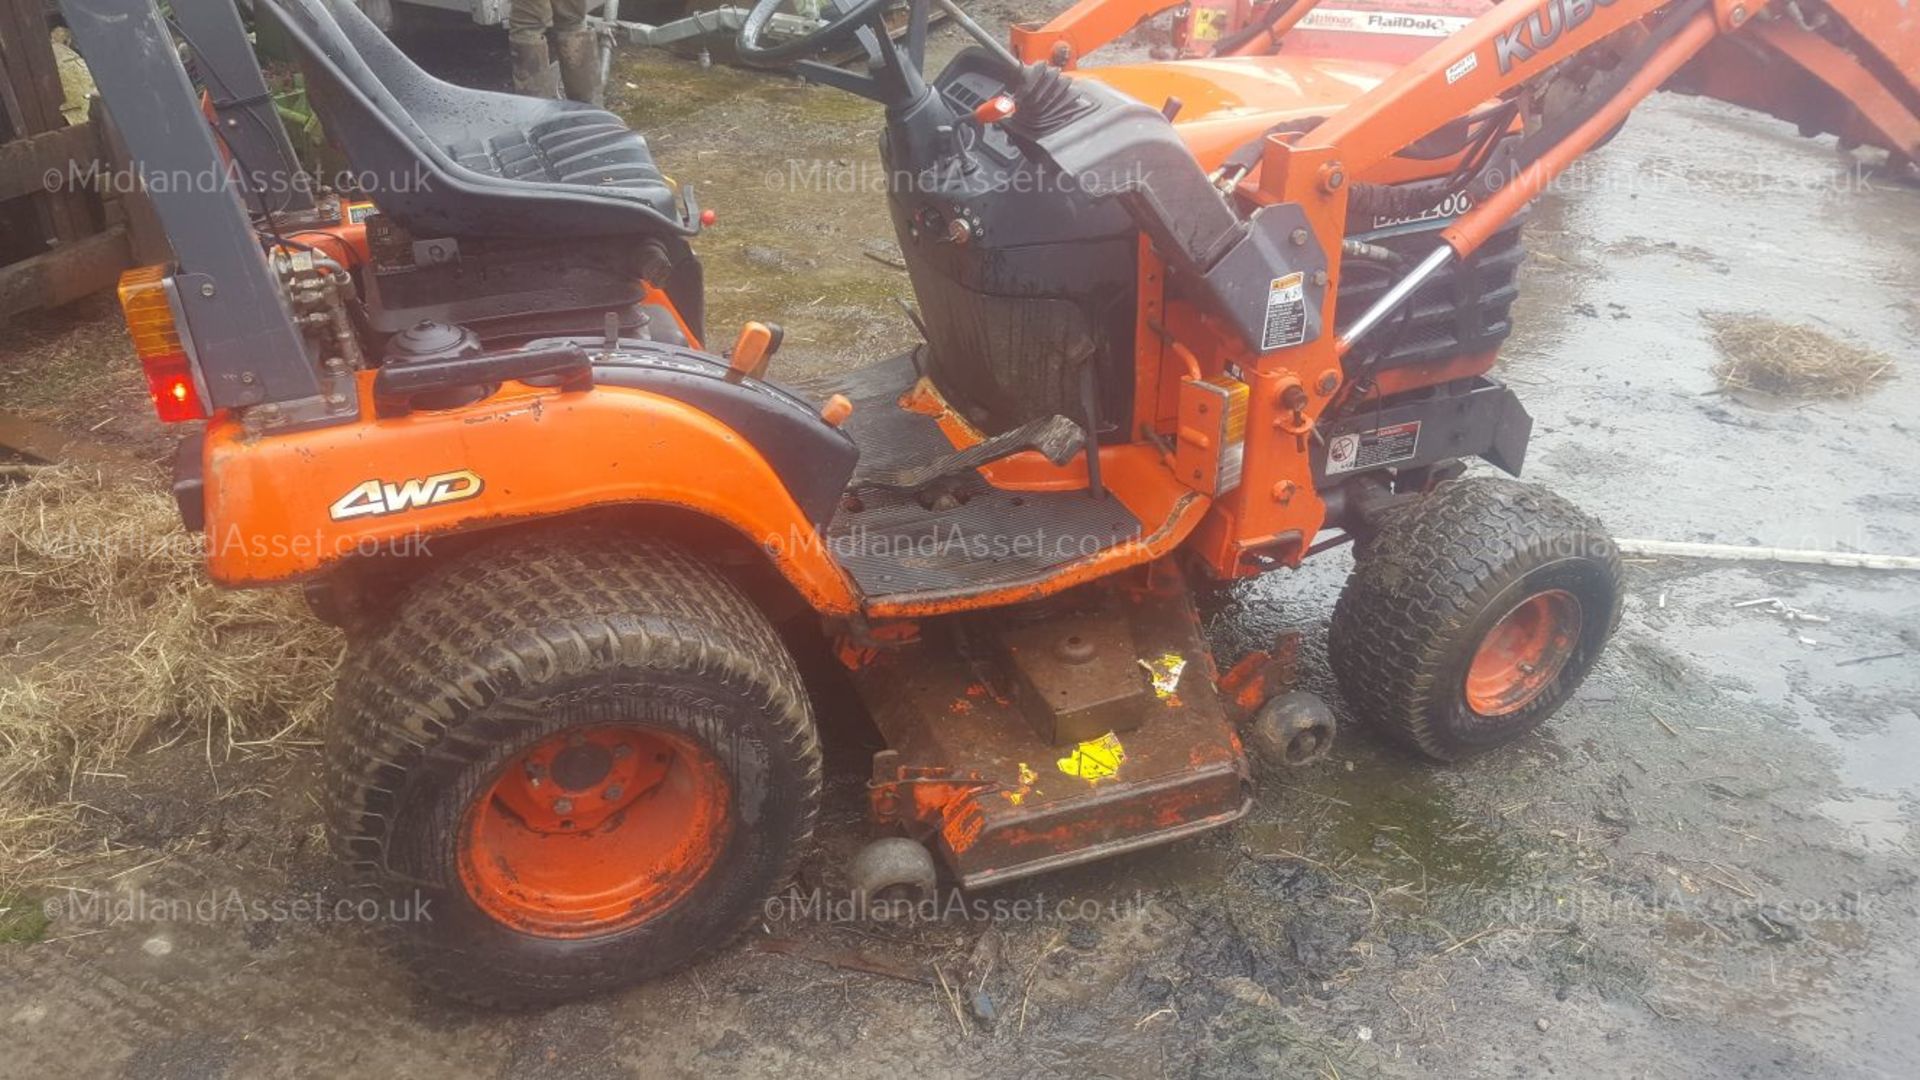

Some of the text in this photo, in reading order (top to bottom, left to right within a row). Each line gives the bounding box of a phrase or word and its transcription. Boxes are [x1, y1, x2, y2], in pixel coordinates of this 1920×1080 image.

[1368, 15, 1439, 31] FlailDok
[1494, 0, 1617, 76] KUB
[328, 470, 485, 521] 4WD
